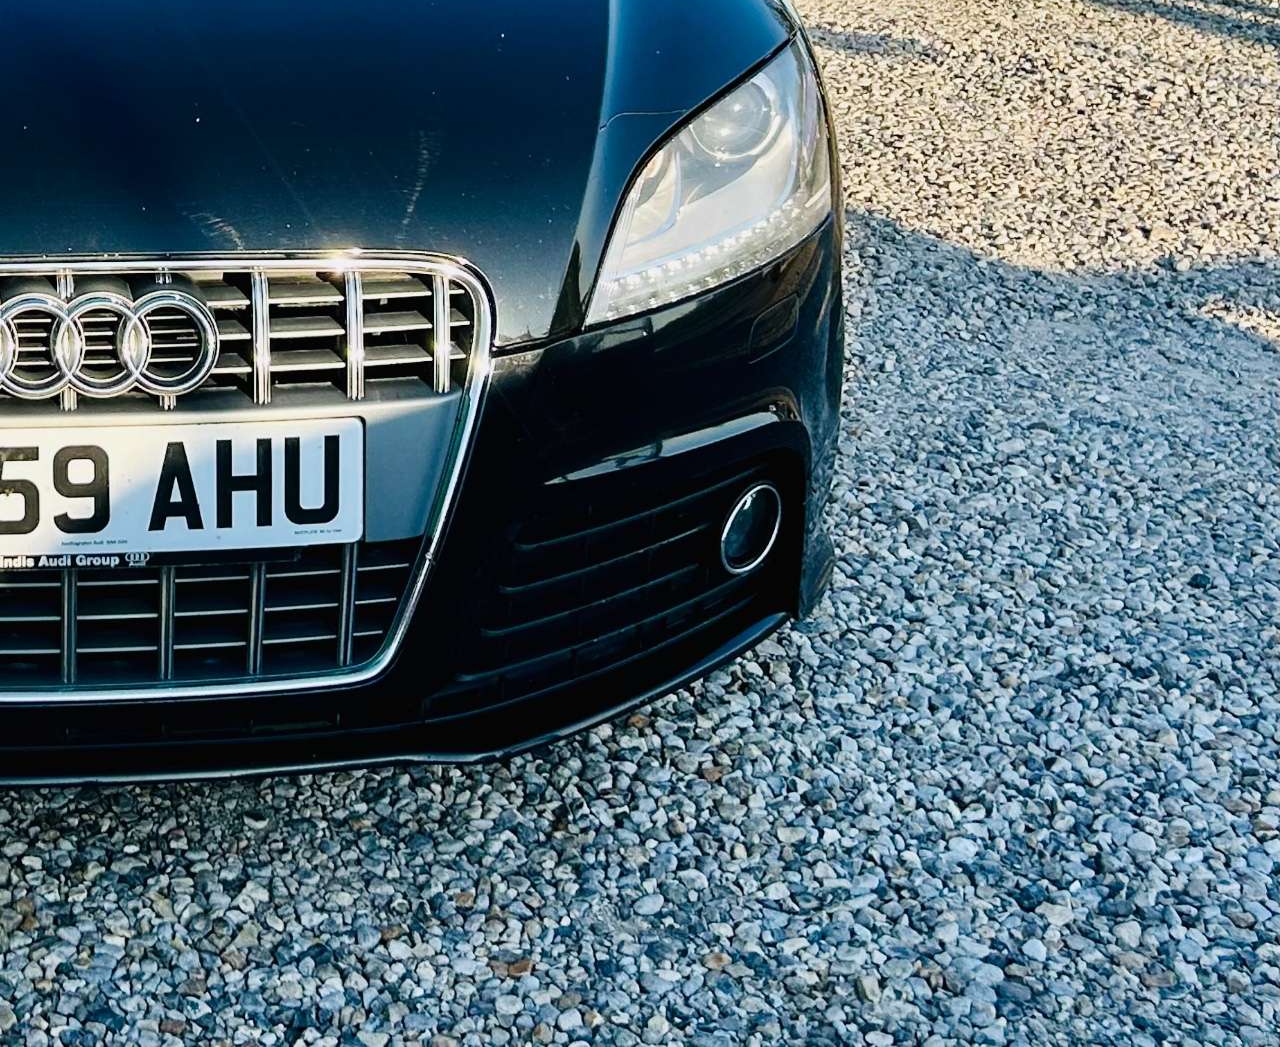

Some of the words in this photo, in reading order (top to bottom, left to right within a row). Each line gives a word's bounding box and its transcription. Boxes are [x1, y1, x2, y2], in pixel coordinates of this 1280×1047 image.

[148, 434, 340, 532] AHU
[38, 554, 71, 567] Audi
[75, 553, 120, 567] Group
